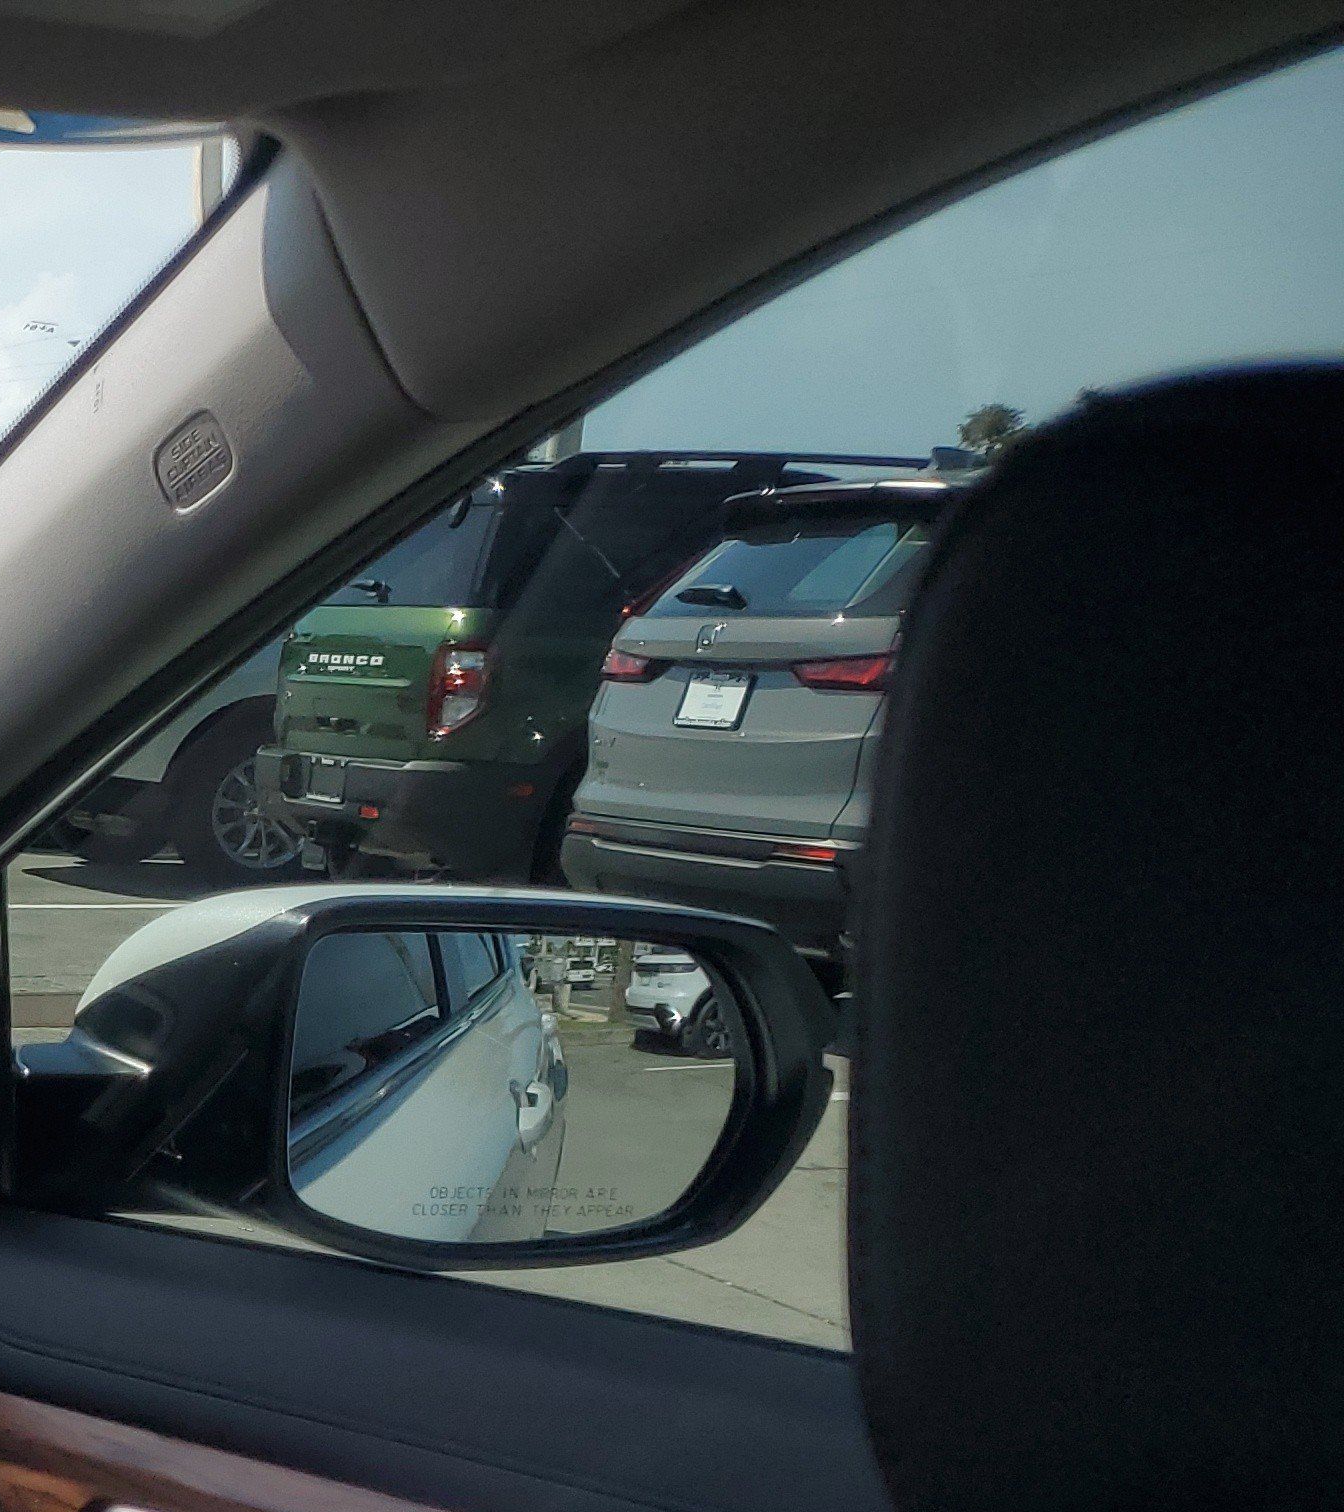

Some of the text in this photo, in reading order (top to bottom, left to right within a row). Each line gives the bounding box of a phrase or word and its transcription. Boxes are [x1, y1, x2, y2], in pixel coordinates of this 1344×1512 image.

[308, 653, 385, 667] BRONCO
[585, 1187, 618, 1201] ARE
[411, 1203, 635, 1218] CLOSER THAN THEY APPEAR
